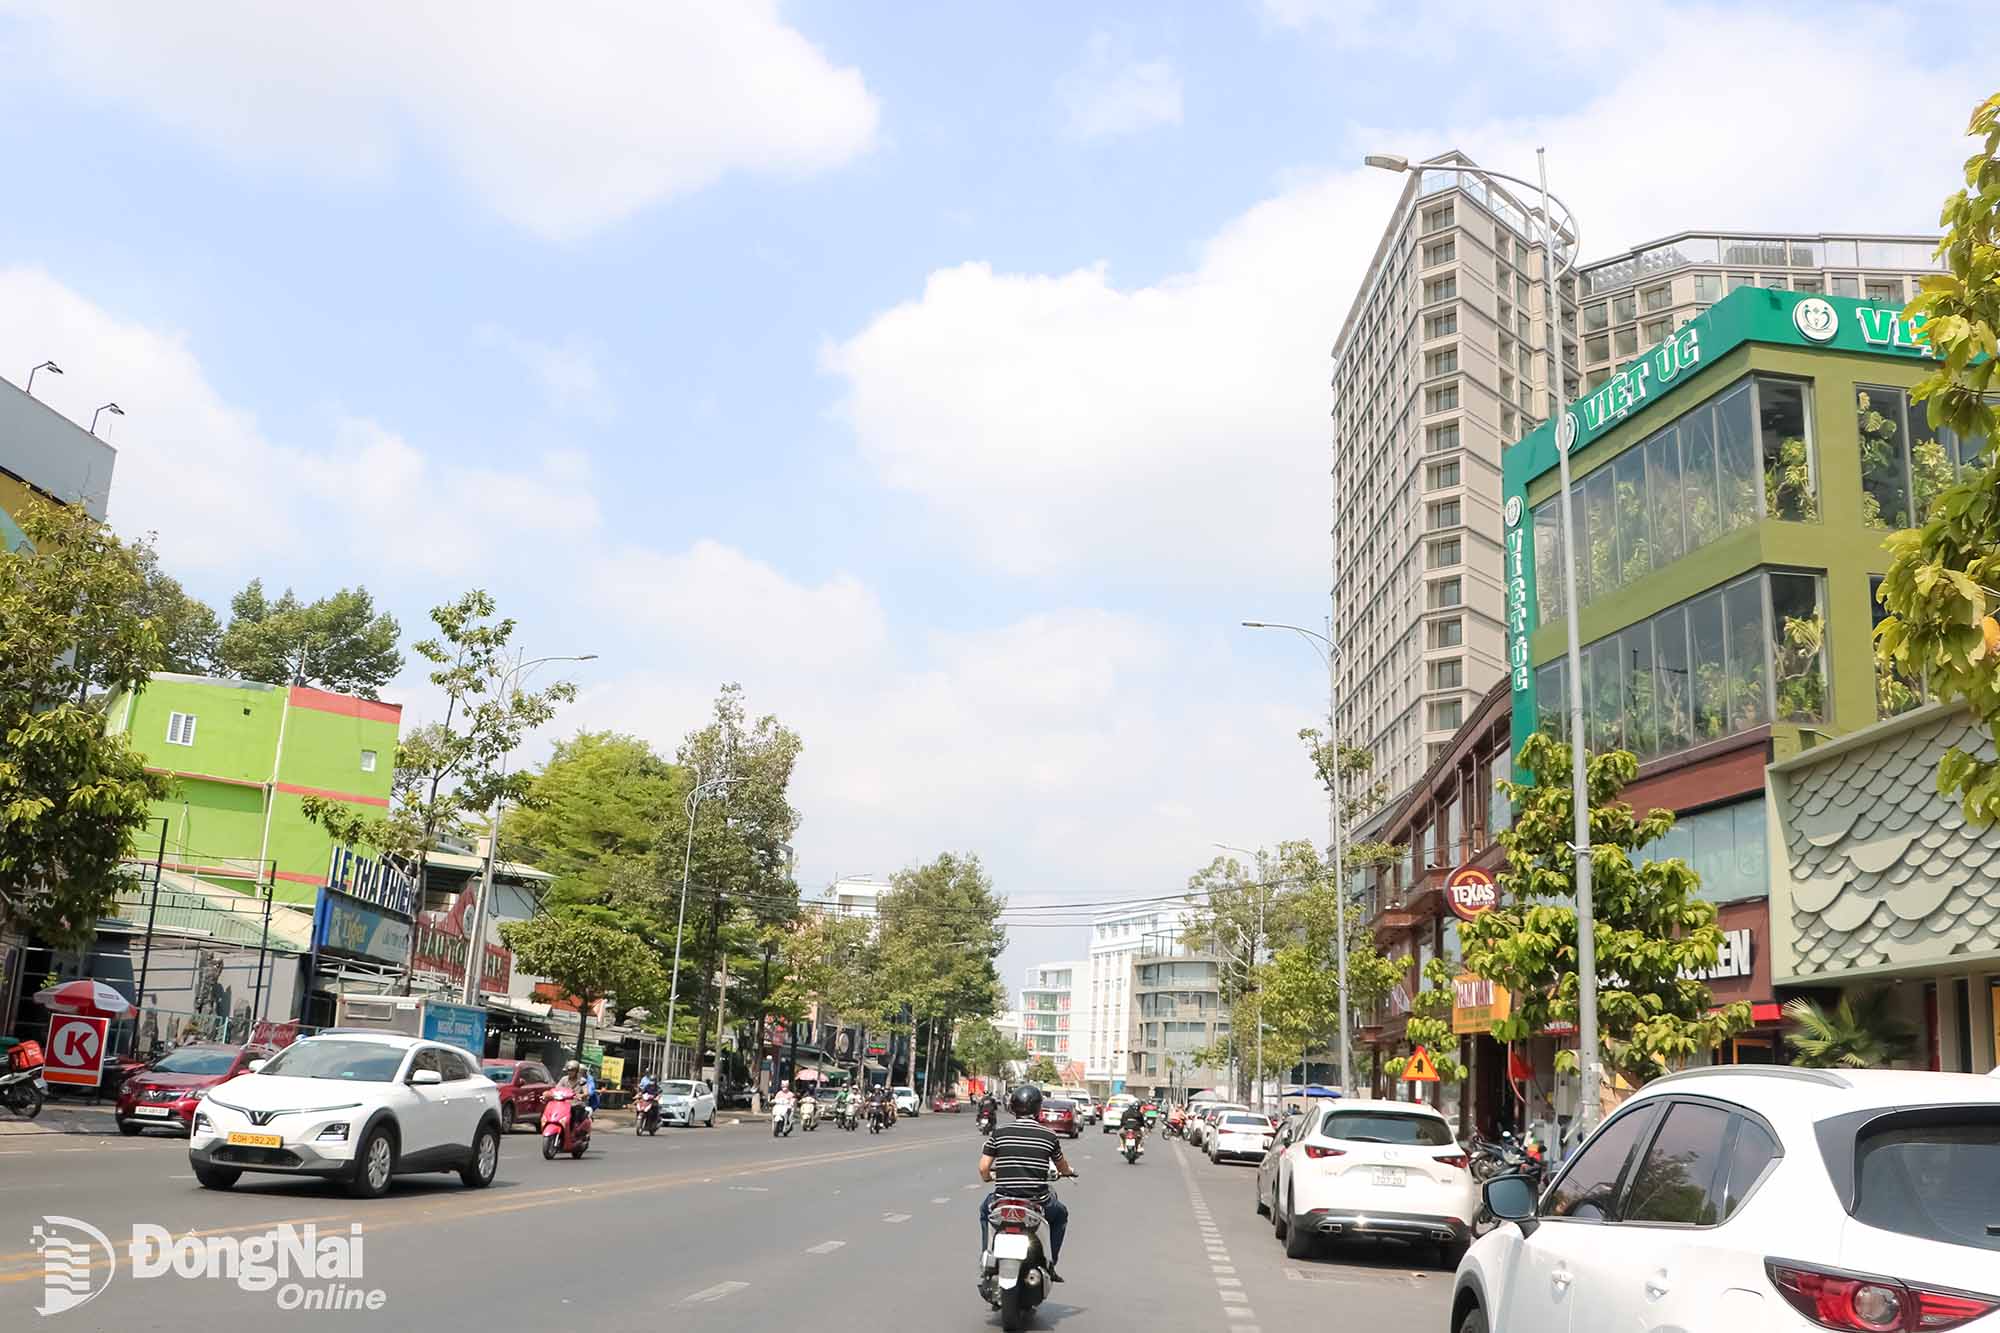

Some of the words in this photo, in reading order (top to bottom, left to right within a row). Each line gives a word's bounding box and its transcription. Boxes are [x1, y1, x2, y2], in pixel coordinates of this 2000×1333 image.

[1583, 361, 1650, 431] VIỆT
[1655, 328, 1700, 383] ÚC
[1450, 882, 1496, 906] TEXAS
[64, 1031, 95, 1064] K
